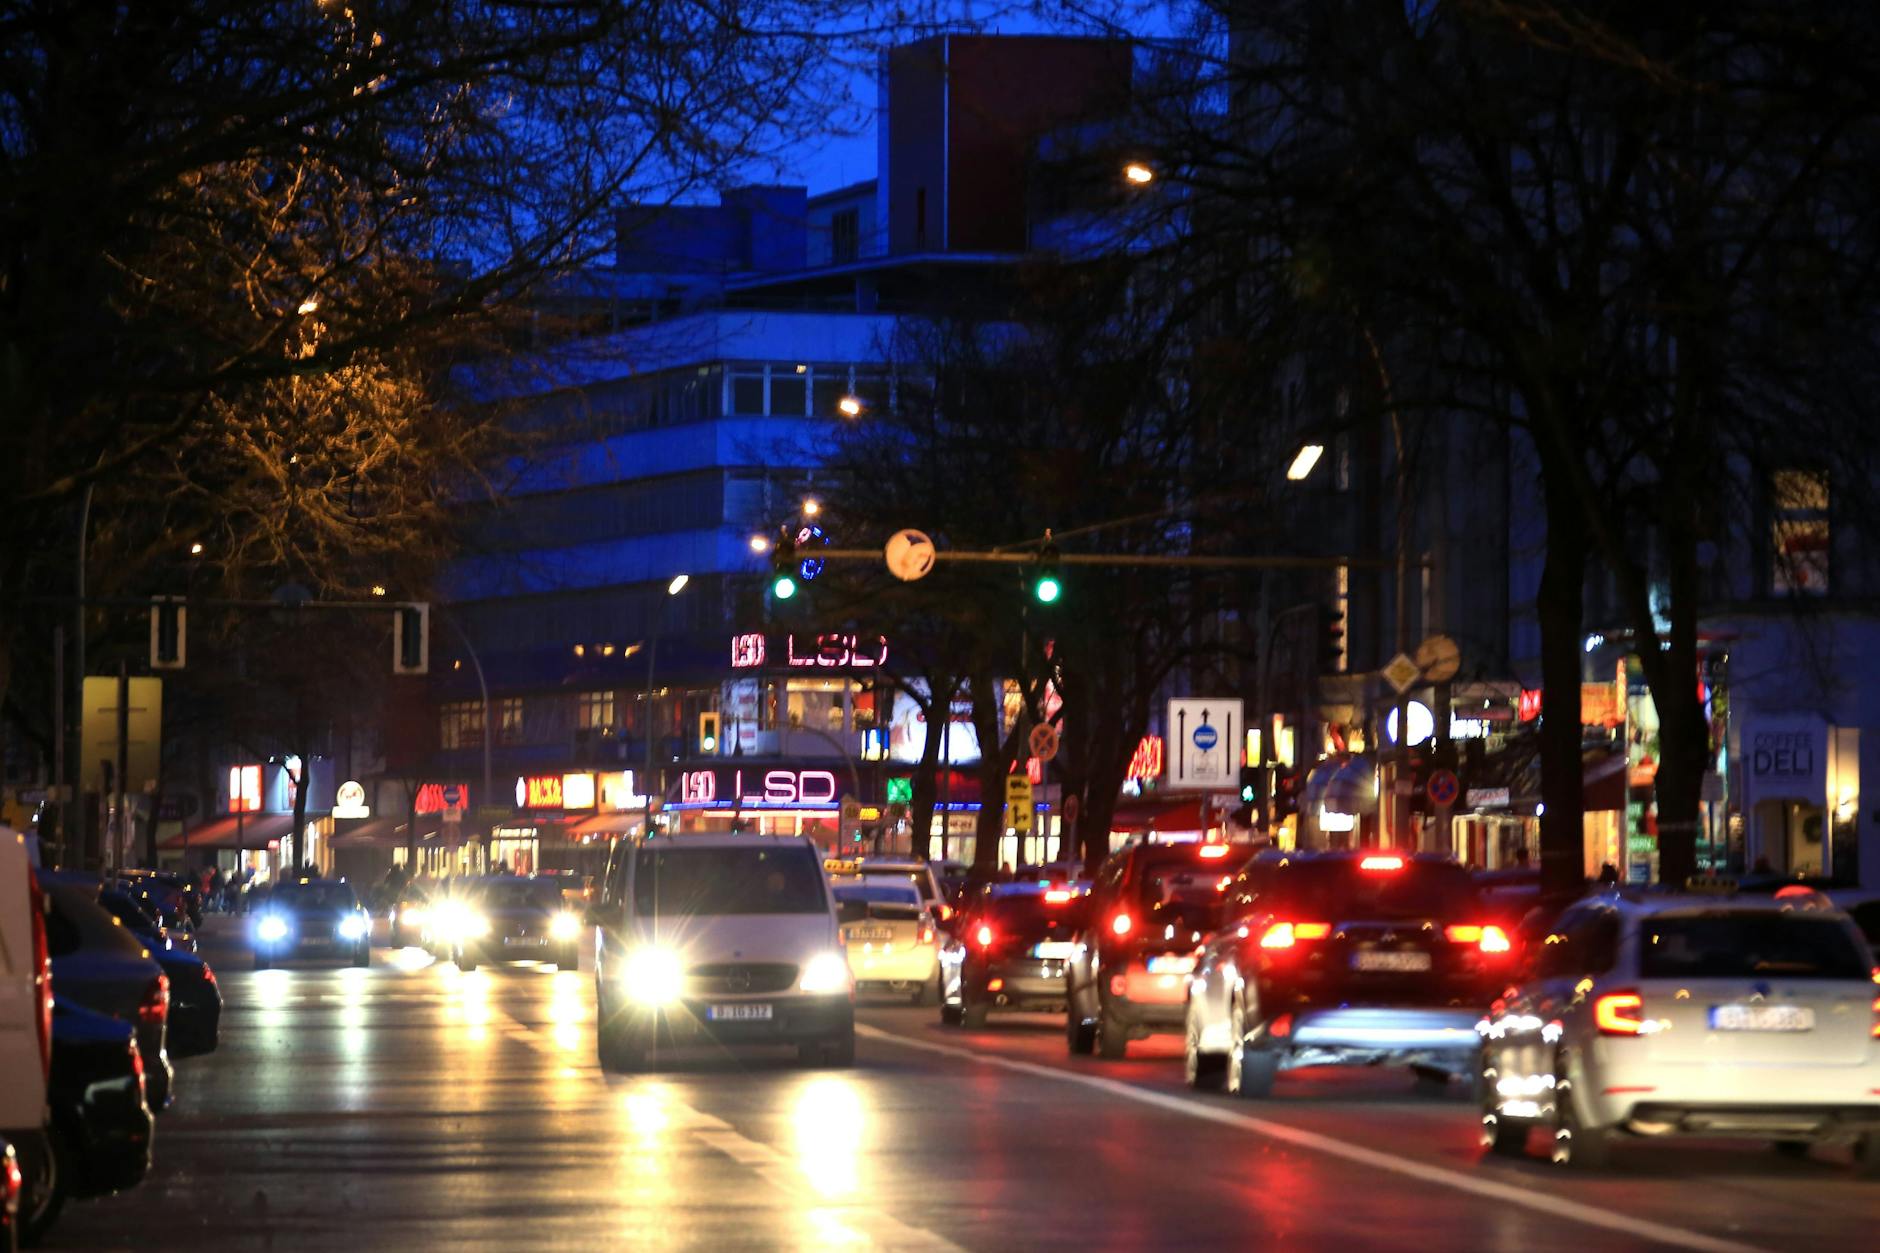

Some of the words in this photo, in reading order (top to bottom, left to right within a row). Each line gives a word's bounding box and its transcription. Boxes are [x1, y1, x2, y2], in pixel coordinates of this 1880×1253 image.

[731, 633, 765, 667] LSD
[1753, 732, 1812, 748] COFFEE
[1753, 749, 1814, 776] DELI
[682, 770, 716, 803] LSD
[735, 769, 836, 804] LSD
